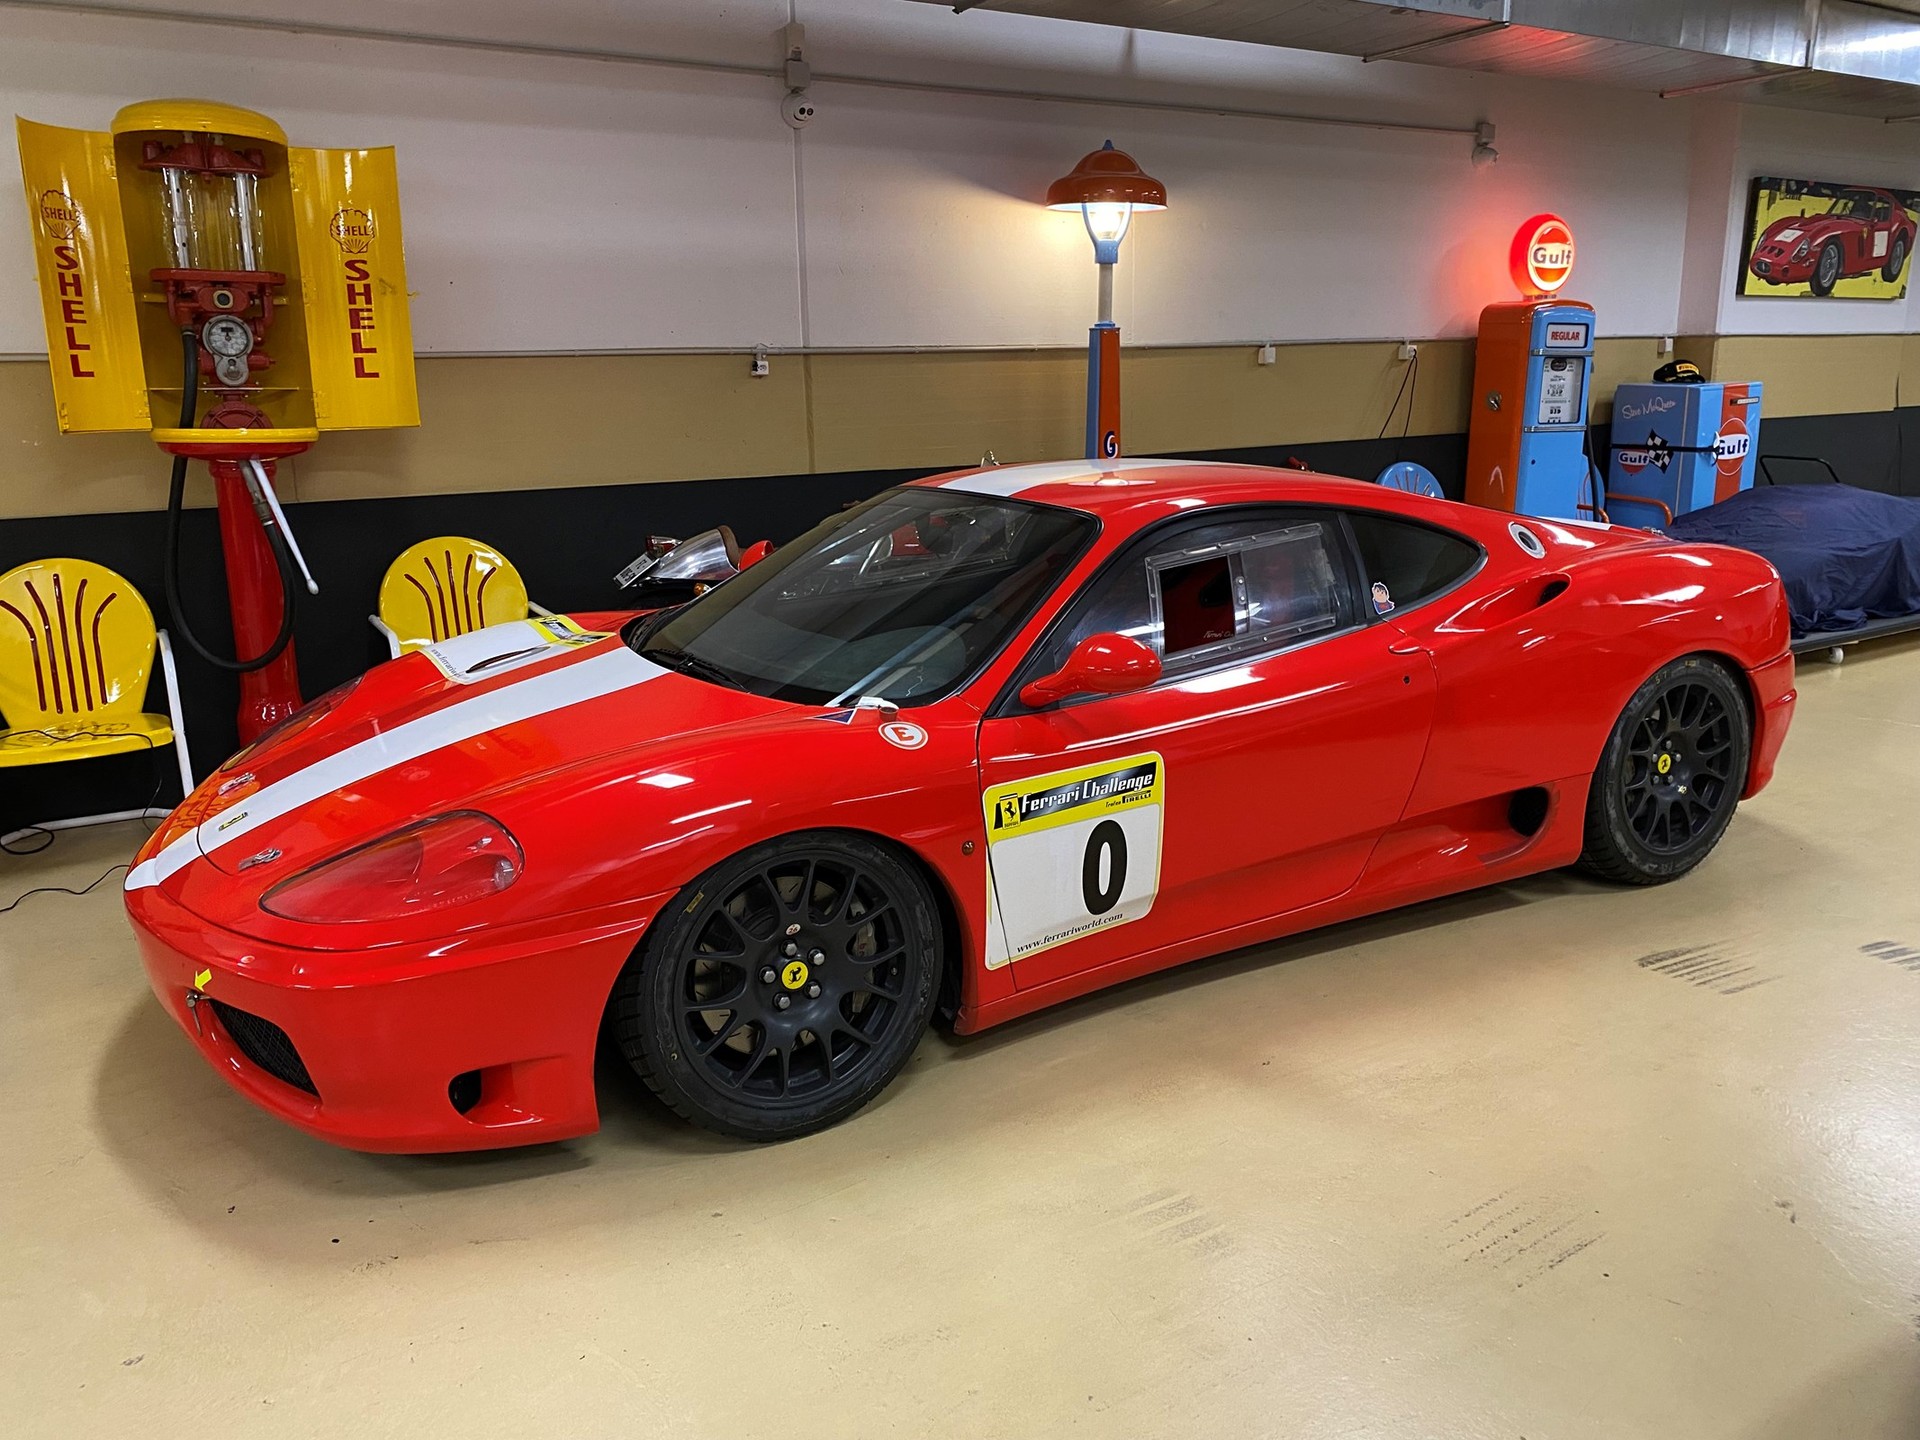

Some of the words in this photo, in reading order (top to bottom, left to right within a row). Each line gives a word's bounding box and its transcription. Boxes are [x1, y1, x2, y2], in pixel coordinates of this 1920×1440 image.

[44, 206, 77, 221] SHELL
[336, 224, 370, 236] SHELL
[1533, 246, 1572, 264] Gulf
[54, 245, 95, 378] SHELL
[344, 258, 380, 378] SHELL
[1551, 331, 1580, 341] REGULAR
[1104, 430, 1118, 459] G
[1718, 438, 1748, 455] Gulf
[1619, 452, 1649, 464] Gulf
[1021, 786, 1080, 814] Ferrari
[1082, 773, 1153, 799] Challenge
[1082, 819, 1128, 916] 0
[1016, 913, 1123, 953] www.ferrariworld.com
